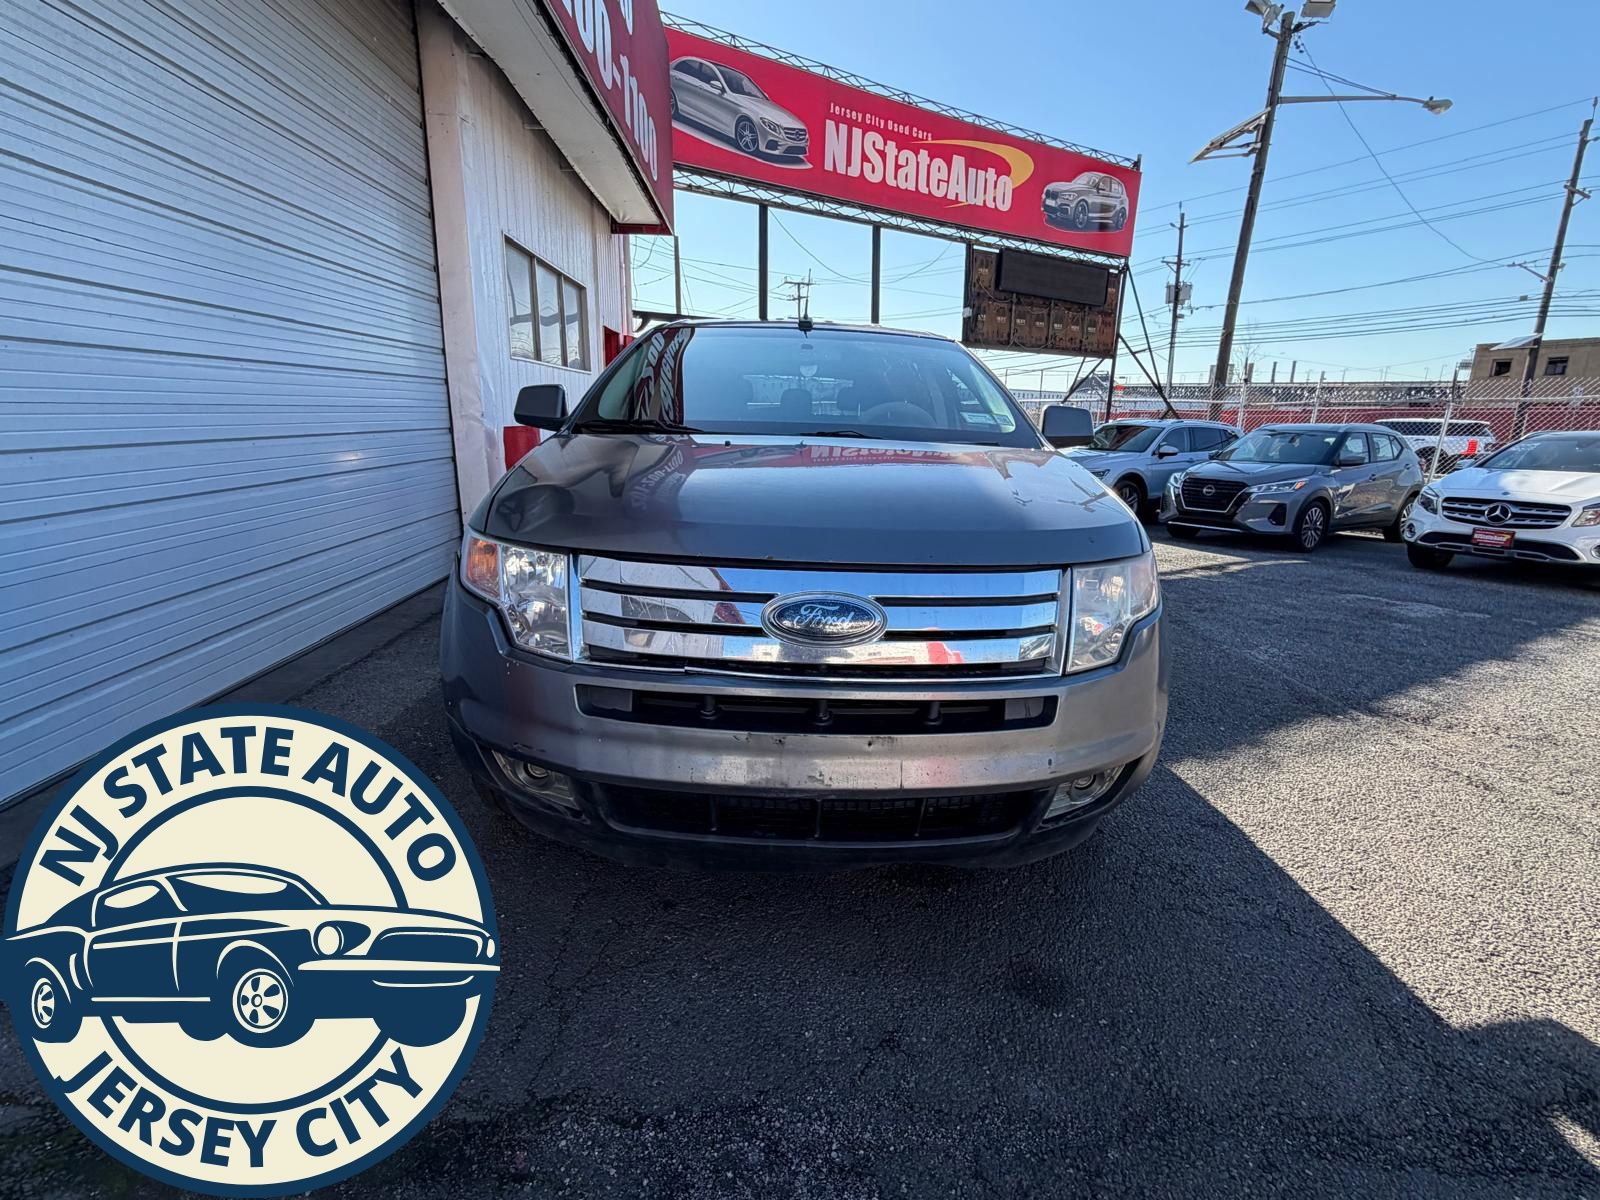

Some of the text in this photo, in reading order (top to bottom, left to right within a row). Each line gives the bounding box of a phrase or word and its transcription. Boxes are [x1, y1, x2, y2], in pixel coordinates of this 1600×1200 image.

[561, 0, 658, 182] 00-1100
[829, 102, 933, 141] Jersey City Used Cars
[824, 118, 1013, 213] NJStateAuto
[793, 603, 855, 626] Ford
